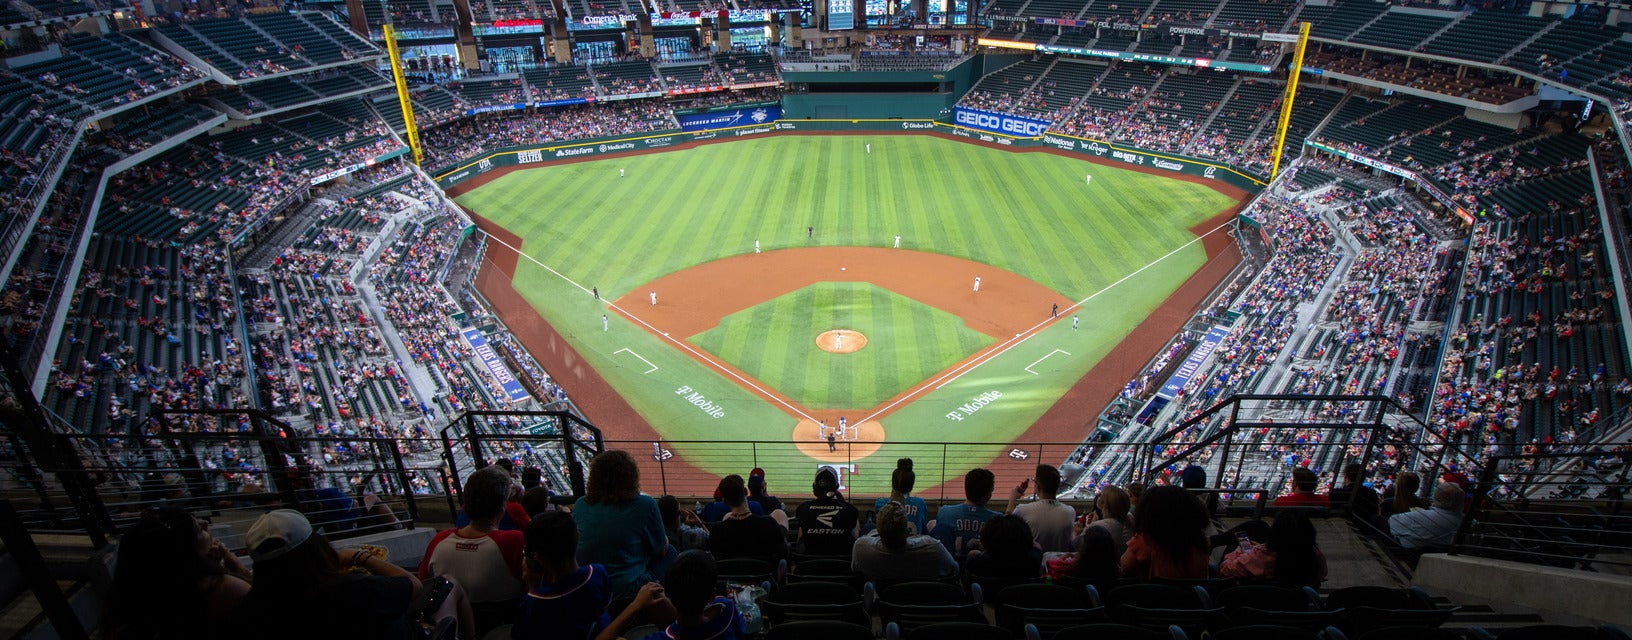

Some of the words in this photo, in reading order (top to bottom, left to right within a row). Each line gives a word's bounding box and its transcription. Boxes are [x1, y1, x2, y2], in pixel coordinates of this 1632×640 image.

[618, 13, 638, 22] Bank
[670, 11, 690, 20] Coca-Cola
[699, 10, 719, 19] Coca-Cola
[1169, 26, 1205, 35] POWERADE
[682, 119, 710, 127] LOCKHEED
[956, 110, 1000, 128] GEICO
[623, 142, 635, 150] City
[1050, 136, 1075, 147] National
[1088, 142, 1108, 155] Kroger
[518, 154, 543, 164] SELTZER
[475, 344, 496, 361] TEXAS
[487, 359, 513, 384] RANGERS
[1175, 361, 1199, 379] TEXAS
[1192, 340, 1216, 363] RANGERS
[684, 391, 725, 419] Mobile
[958, 390, 1003, 415] Mobile
[531, 423, 552, 433] TOYOTA
